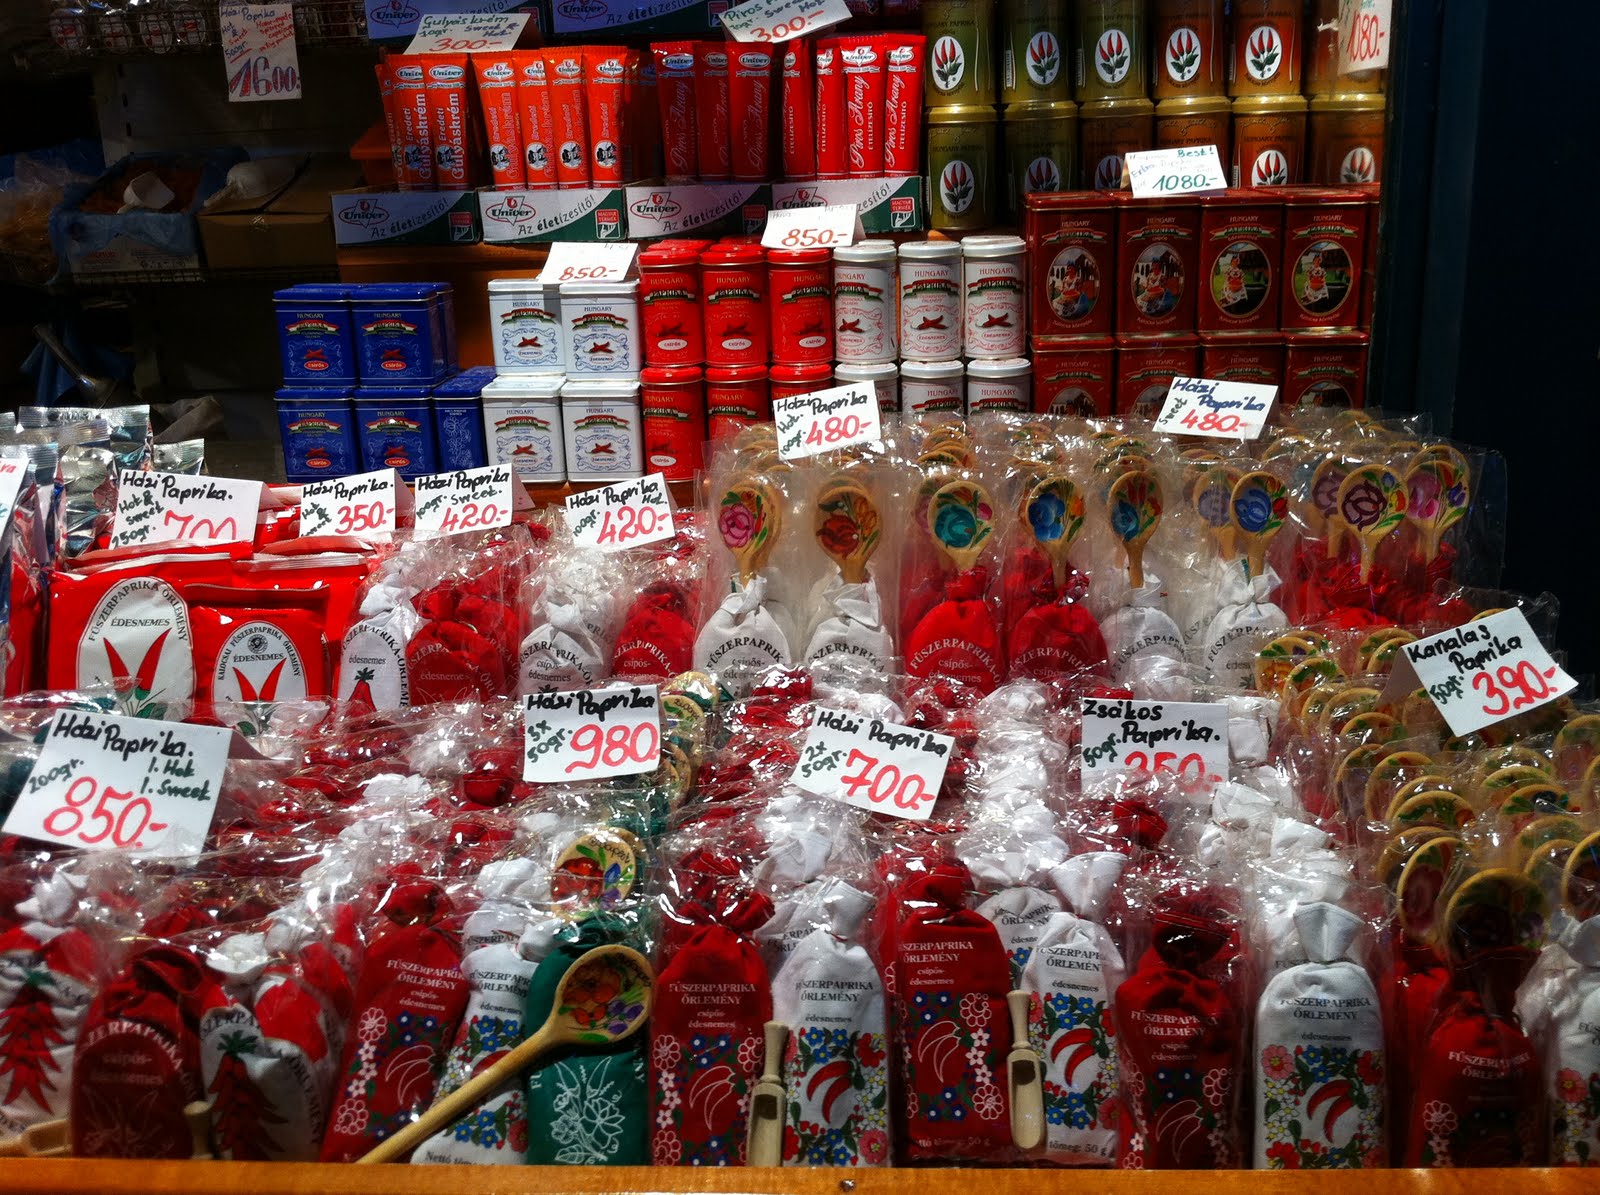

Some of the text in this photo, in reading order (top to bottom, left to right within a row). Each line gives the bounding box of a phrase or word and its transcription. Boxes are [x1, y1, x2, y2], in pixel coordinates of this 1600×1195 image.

[607, 13, 623, 25] Az
[491, 209, 532, 217] Univer
[636, 205, 678, 213] Univer
[518, 224, 533, 235] Az
[663, 221, 678, 232] Az
[781, 228, 848, 247] 850.-
[559, 265, 618, 281] 850.-
[716, 276, 750, 284] HUNGARY
[980, 267, 1014, 275] HUNGARY
[650, 277, 684, 285] HUNGARY
[916, 282, 951, 290] PAPRIKA
[980, 281, 1014, 289] PAPRIKA
[1172, 378, 1220, 394] Házi
[811, 391, 868, 416] Paprika
[1197, 394, 1267, 413] Paprika
[1180, 409, 1248, 433] 480.-
[805, 414, 873, 447] 480.-
[122, 471, 233, 504] Házi Paprika.
[303, 479, 336, 499] Házi
[417, 468, 511, 492] Házi Paprika
[118, 490, 154, 514] Hot &
[570, 479, 659, 509] Házi Paprika
[335, 501, 395, 534] 350.-
[440, 503, 509, 532] 420.-
[596, 506, 670, 544] 420.-
[110, 618, 171, 627] ÉDESNEMES
[1407, 625, 1492, 663] Kanalas
[233, 653, 284, 663] ÉDESNEMES
[348, 656, 386, 665] édesnemes
[1449, 636, 1523, 674] Paprika
[528, 669, 572, 682] édesnemes
[1472, 661, 1559, 715] 390.-
[527, 693, 576, 711] Házi
[577, 687, 656, 722] Paprika
[1082, 700, 1163, 721] Zsákos
[102, 723, 194, 762] Paprika.
[817, 711, 948, 758] Házi Paprika
[1121, 720, 1221, 748] Paprika.
[163, 760, 196, 778] Hot
[841, 748, 936, 810] 700.-
[156, 779, 211, 801] Sweet
[43, 776, 168, 848] 850.-
[397, 973, 458, 991] ŐRLEMÉNY
[669, 983, 757, 993] FŰSZERPAPRIKA
[909, 976, 955, 986] édesnemes
[1052, 979, 1100, 992] édesnemes
[398, 999, 446, 1012] édesnemes
[681, 994, 743, 1005] ŐRLEMÉNY
[805, 1013, 853, 1024] édesnemes
[1293, 1009, 1358, 1020] ŐRLEMÉNY
[688, 1020, 736, 1029] édesnemes
[1085, 1143, 1098, 1153] 50
